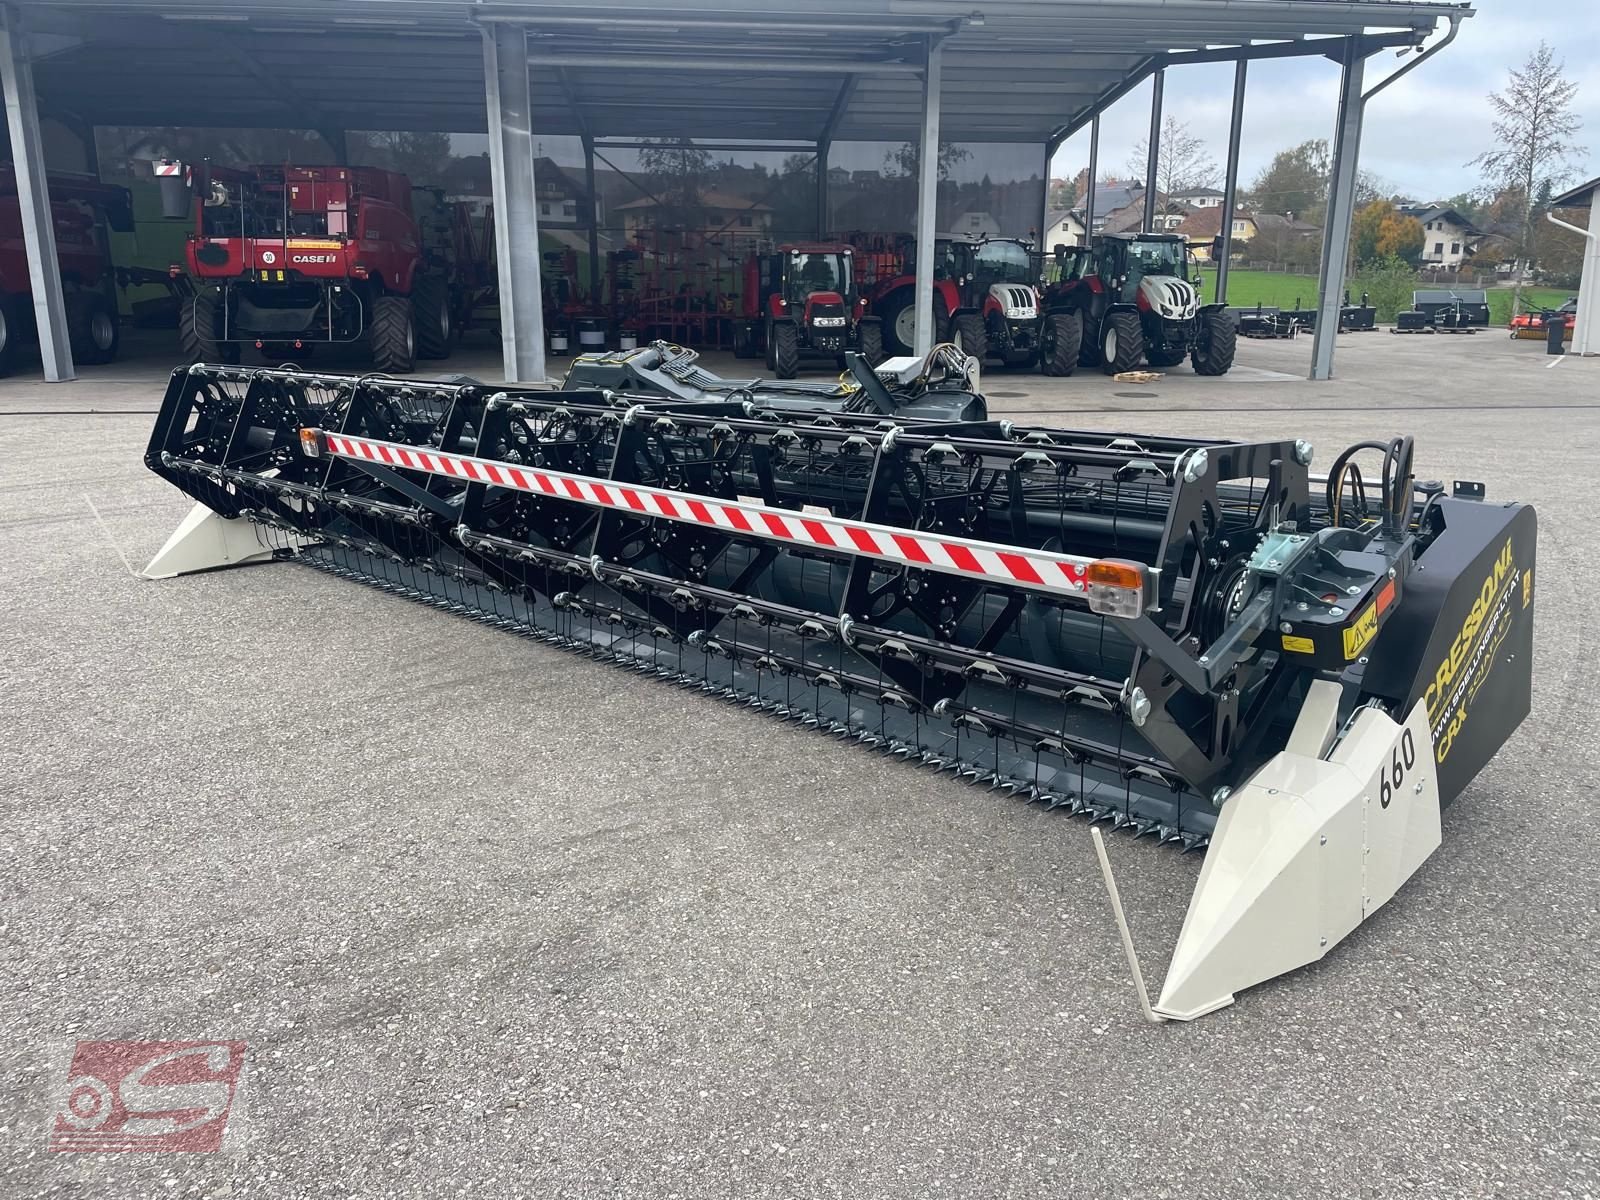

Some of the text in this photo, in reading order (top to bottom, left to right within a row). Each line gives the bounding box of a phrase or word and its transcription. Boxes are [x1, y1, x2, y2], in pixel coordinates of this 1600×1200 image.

[265, 253, 273, 262] 30
[292, 255, 325, 263] CASE
[1438, 698, 1467, 763] CRX
[1380, 727, 1415, 810] 660
